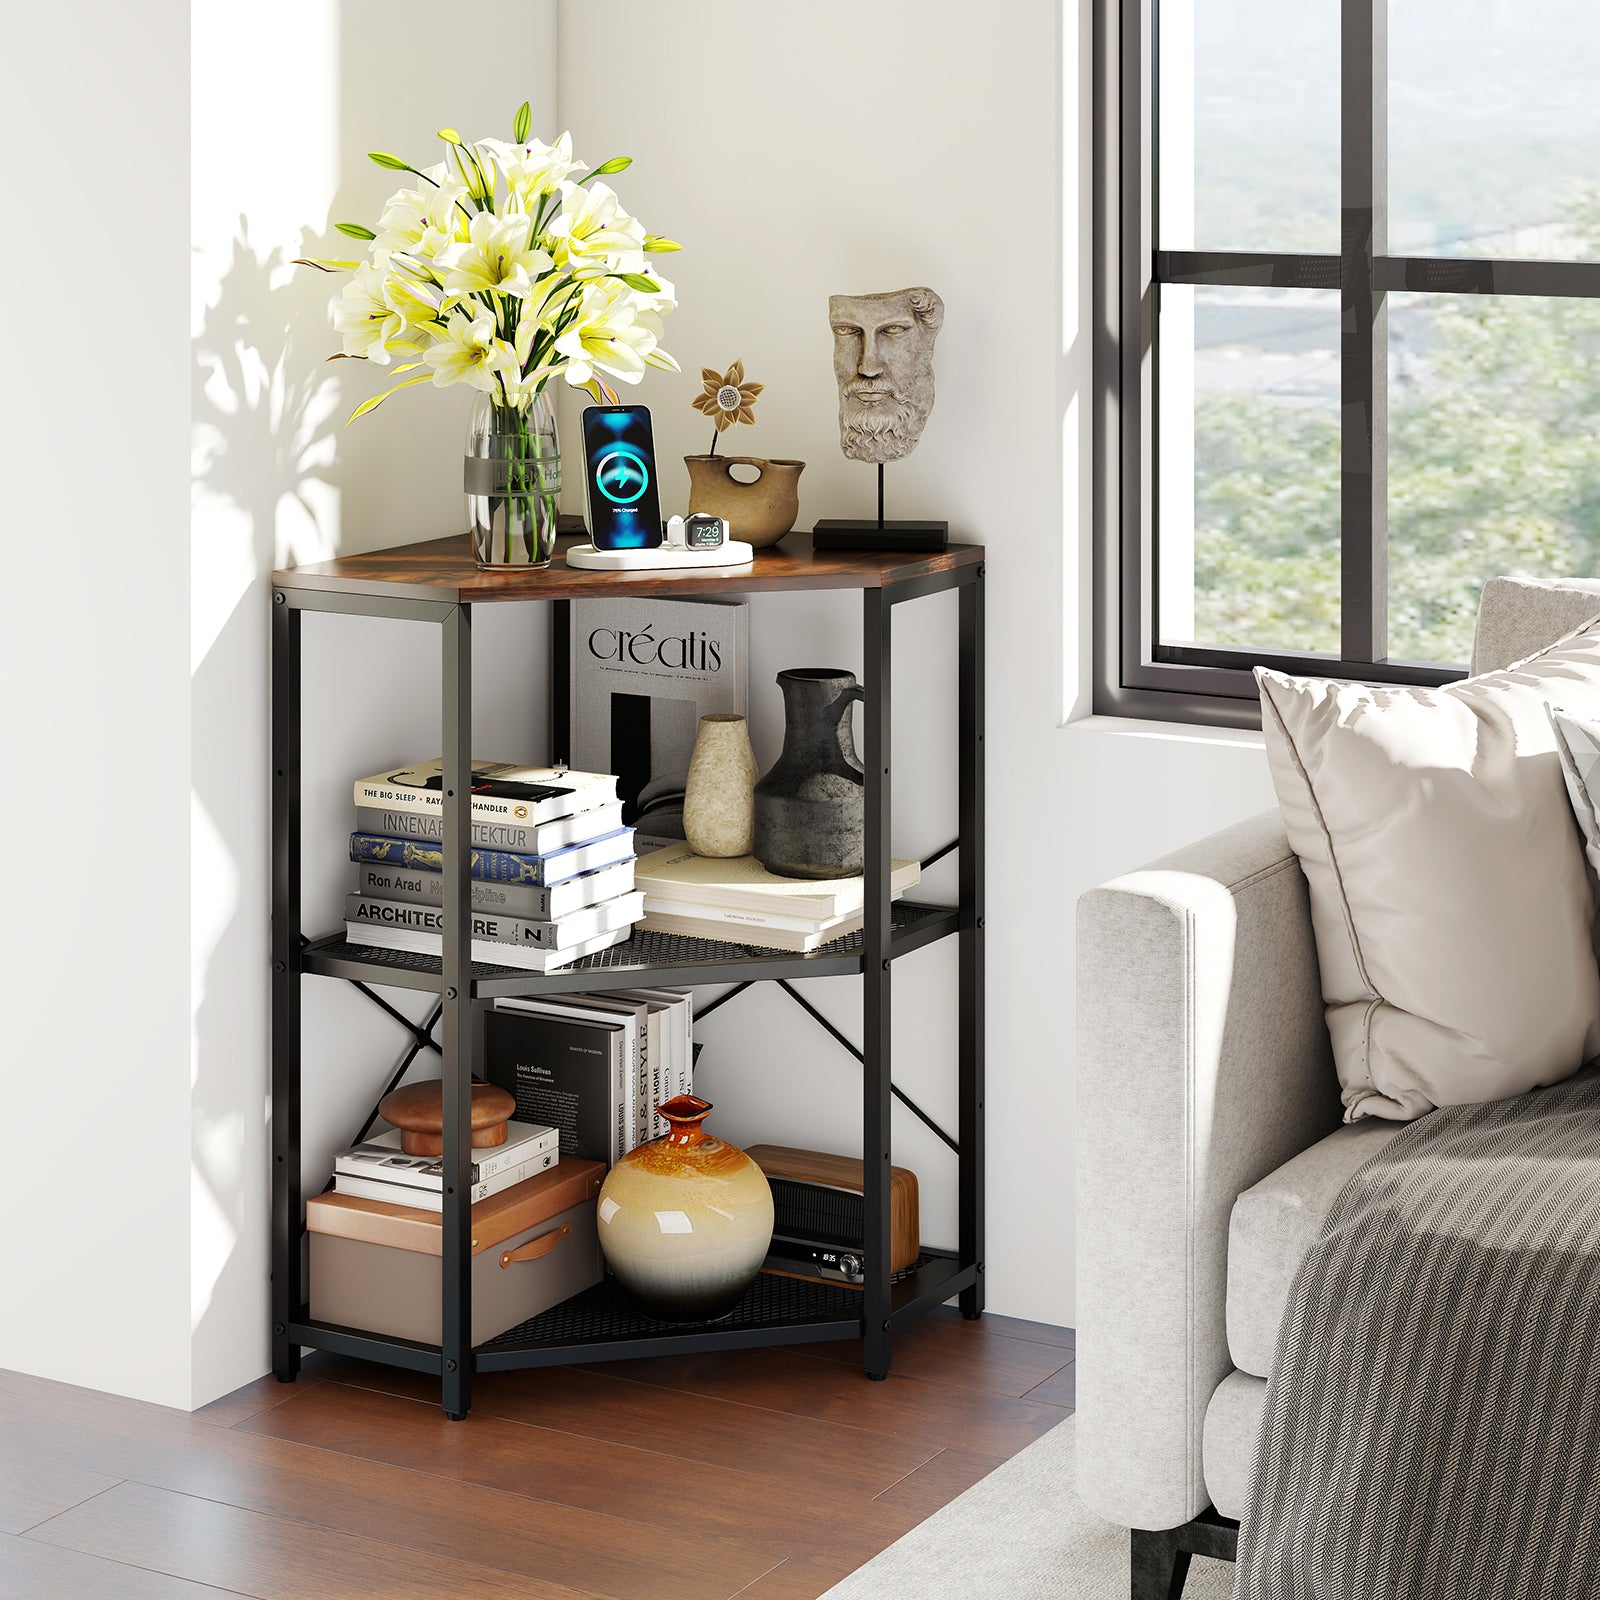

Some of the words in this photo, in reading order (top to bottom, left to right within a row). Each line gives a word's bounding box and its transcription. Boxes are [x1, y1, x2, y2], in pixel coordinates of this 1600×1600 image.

[696, 526, 719, 538] 7:29
[588, 623, 722, 672] créatis
[364, 789, 377, 798] THE
[380, 791, 393, 800] BIG
[395, 793, 416, 802] SLEEP
[426, 796, 443, 805] RAY
[471, 802, 508, 814] HANDLER
[368, 872, 391, 888] Ron
[394, 876, 421, 892] Arad
[516, 1063, 530, 1073] Louis
[530, 1065, 552, 1076] Sullivan
[640, 1023, 648, 1096] STYLE
[640, 1103, 648, 1118] &
